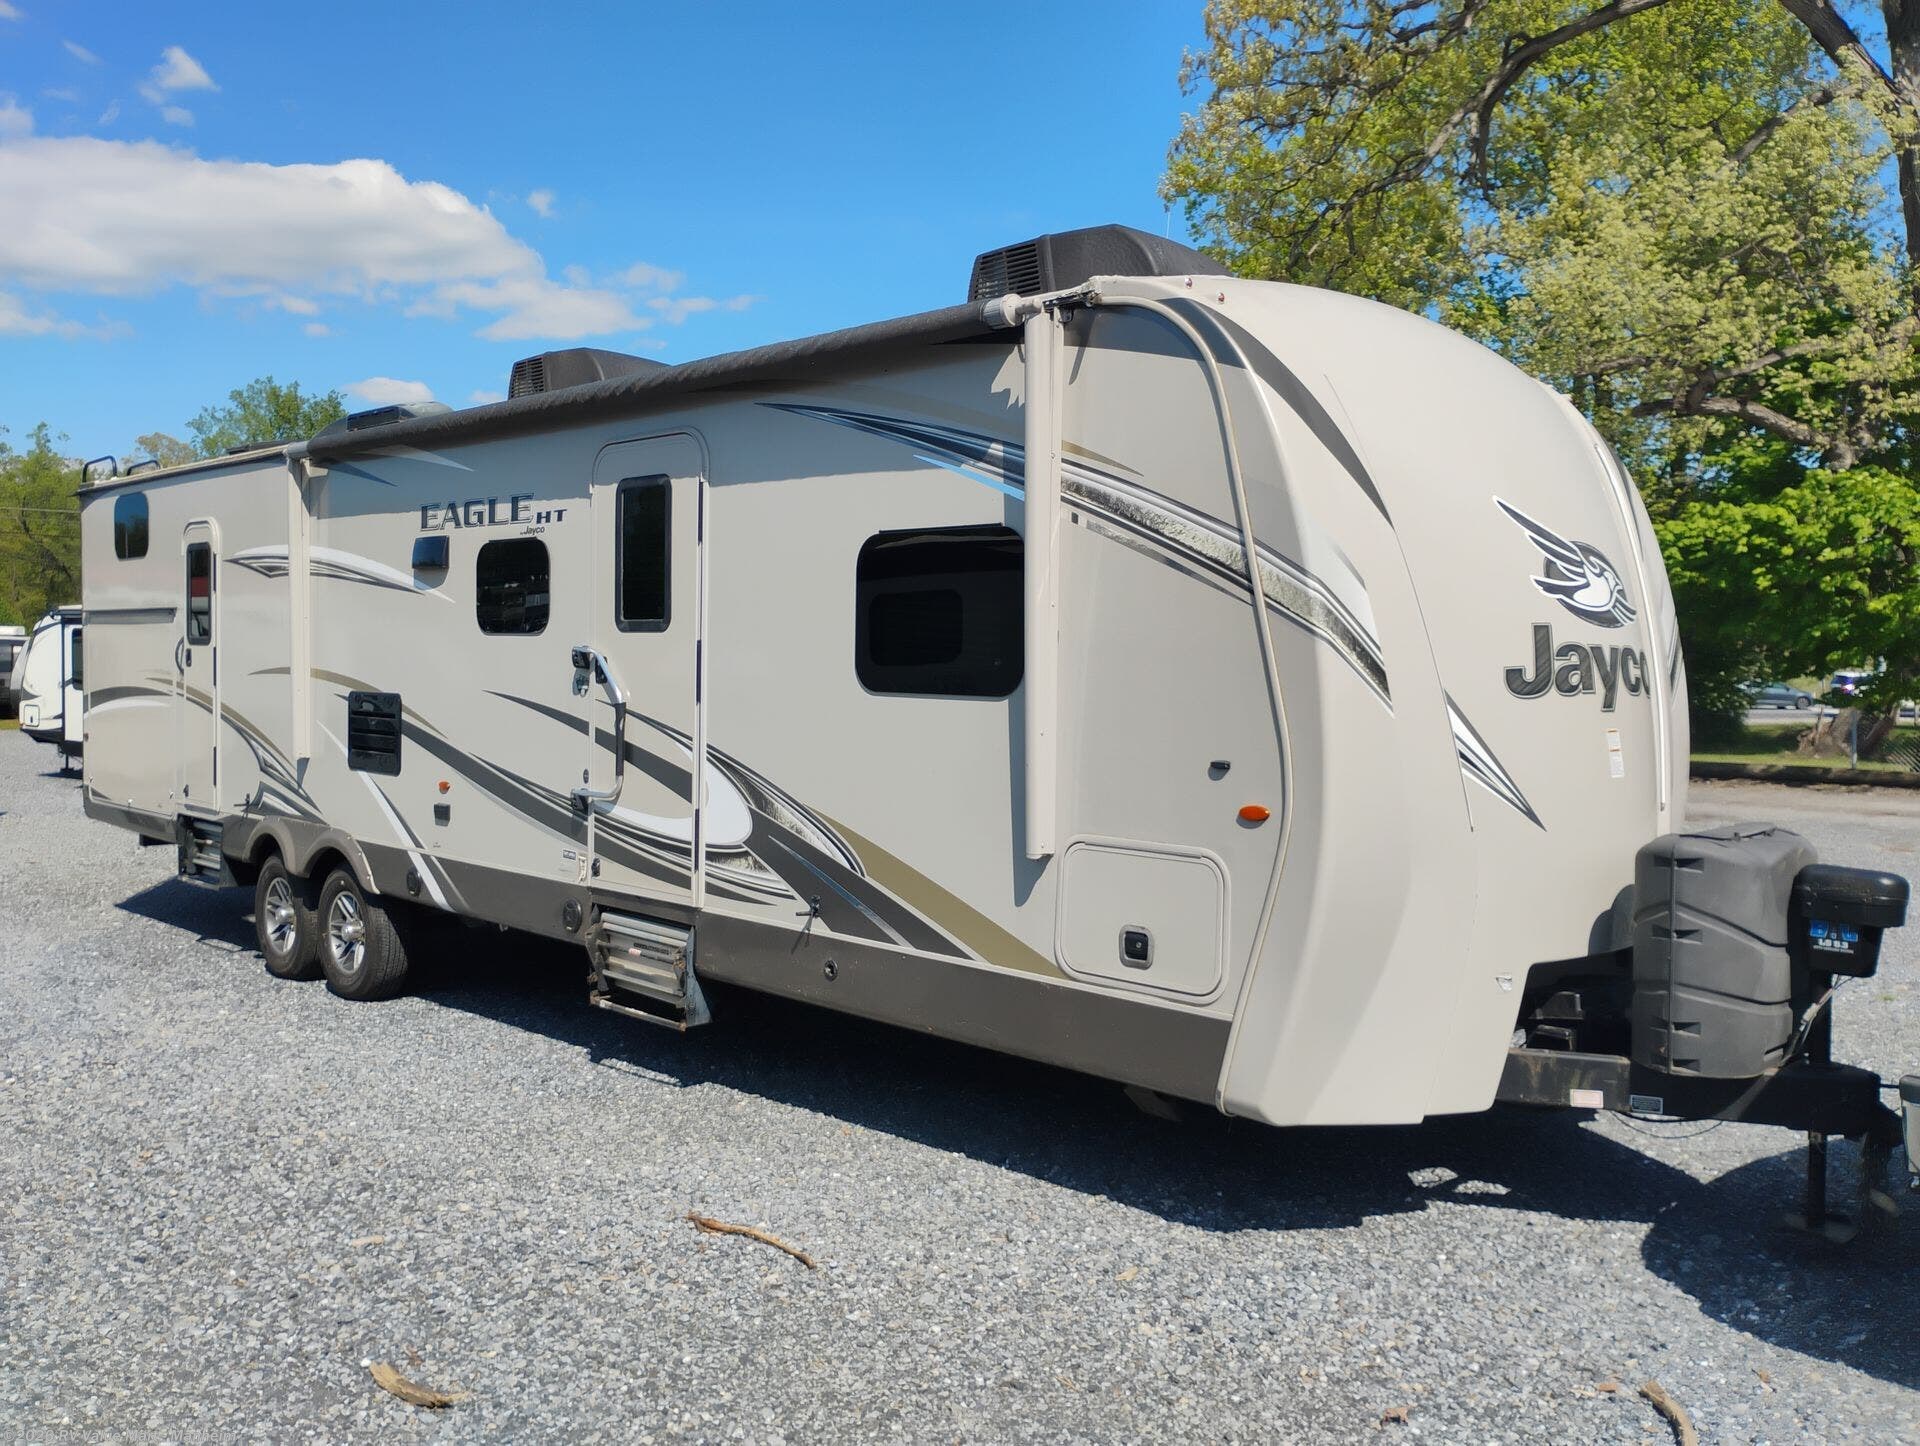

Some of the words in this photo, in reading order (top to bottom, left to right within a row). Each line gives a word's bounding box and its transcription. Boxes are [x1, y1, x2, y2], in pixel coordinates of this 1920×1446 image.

[420, 492, 535, 531] EAGLE
[536, 509, 568, 524] HT
[526, 526, 546, 535] Jayco
